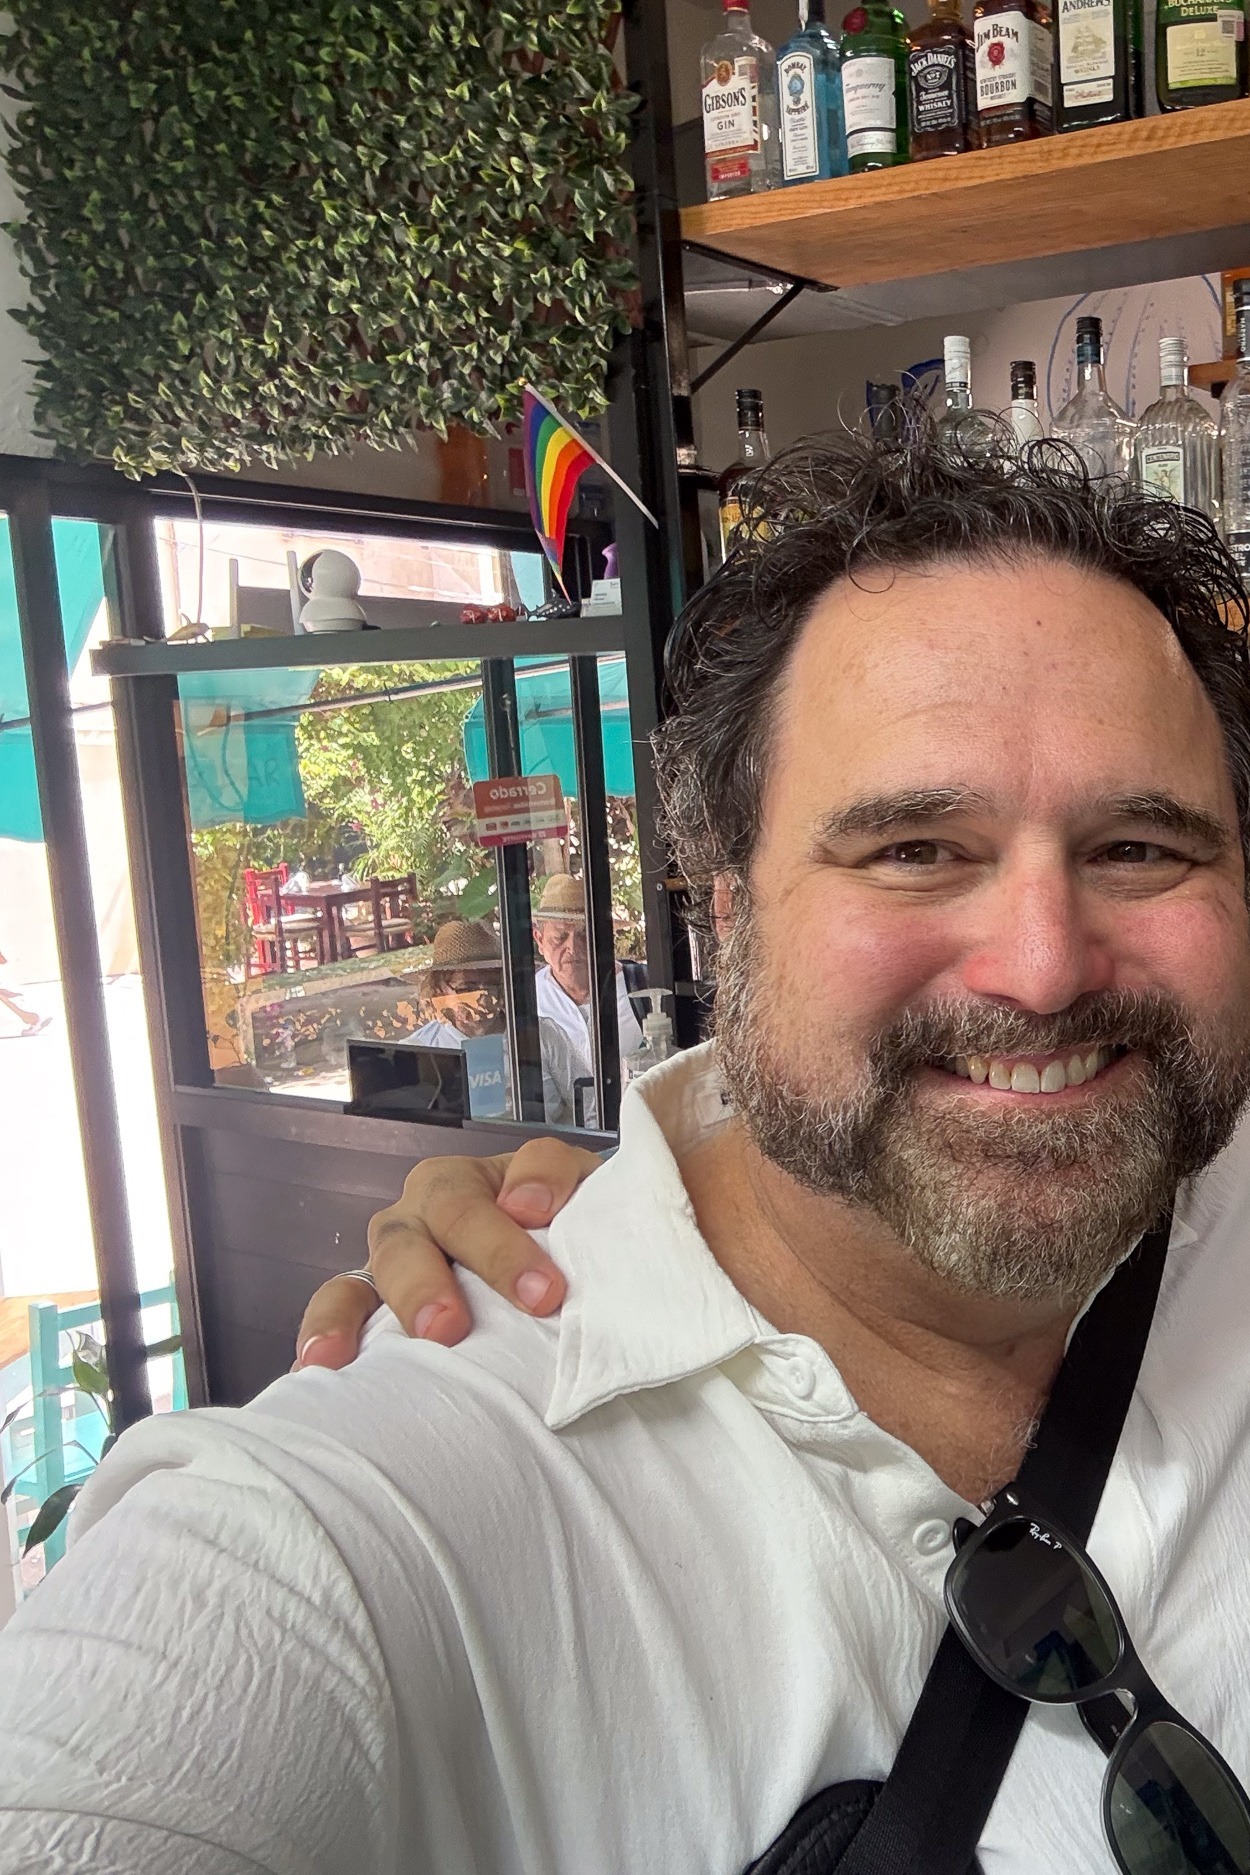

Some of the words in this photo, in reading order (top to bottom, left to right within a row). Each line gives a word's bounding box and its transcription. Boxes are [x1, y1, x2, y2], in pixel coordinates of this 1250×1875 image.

[976, 29, 991, 53] JIM
[992, 23, 1019, 43] BEAM
[910, 57, 928, 77] JACK
[980, 79, 1018, 97] BOURBON
[704, 87, 747, 114] GIBSON'S
[918, 100, 952, 112] WHISKEY
[716, 119, 736, 131] GIN
[468, 1071, 502, 1090] VISA
